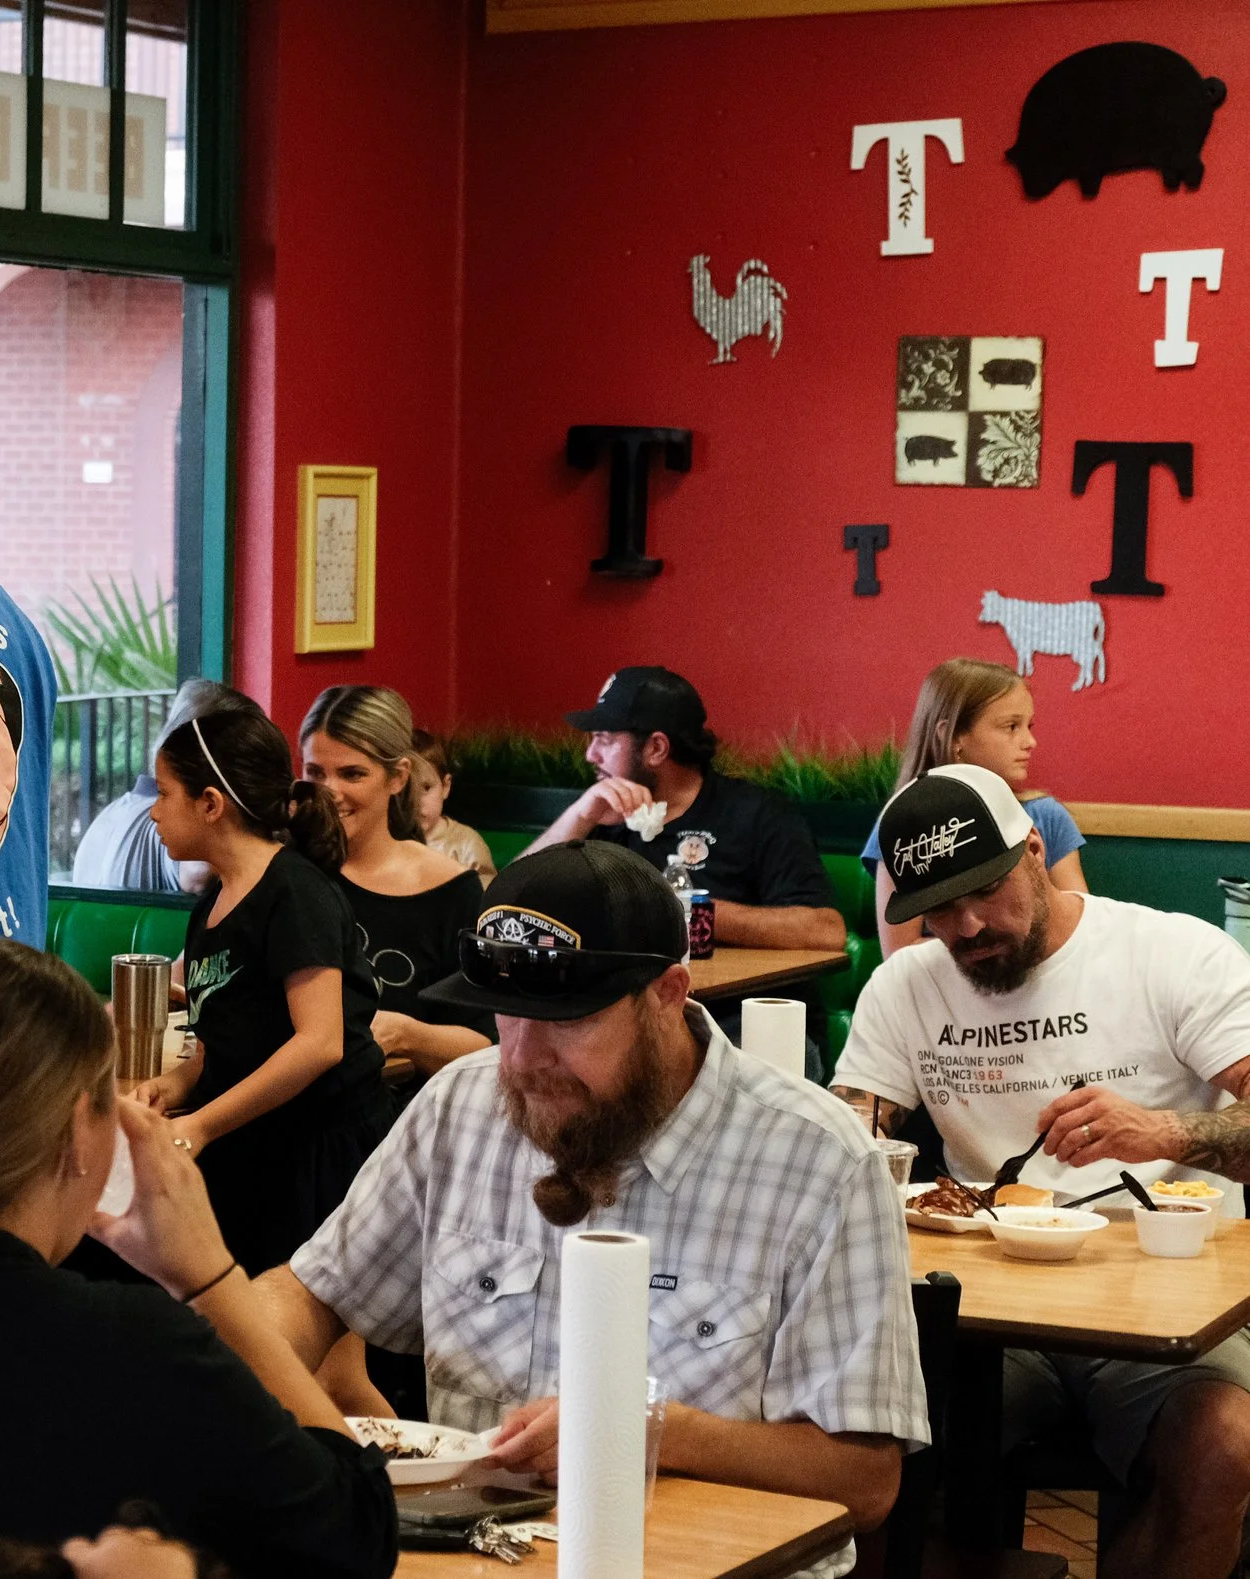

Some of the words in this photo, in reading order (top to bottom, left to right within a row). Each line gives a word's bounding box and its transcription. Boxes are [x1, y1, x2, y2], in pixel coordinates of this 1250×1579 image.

[851, 118, 965, 256] T
[1139, 248, 1224, 367] T
[568, 425, 693, 577] T
[1072, 440, 1194, 596] T
[843, 524, 889, 596] T
[519, 913, 552, 932] PSYCHIC
[551, 925, 576, 945] FORCE
[937, 1056, 965, 1066] GOAL
[987, 1054, 1024, 1067] VISION
[938, 1012, 1089, 1048] ALPINESTARS
[936, 1077, 981, 1093] ANELES
[982, 1080, 1050, 1094] CALIFORNIA
[1061, 1071, 1104, 1087] VENICE
[1107, 1065, 1140, 1080] ITALY
